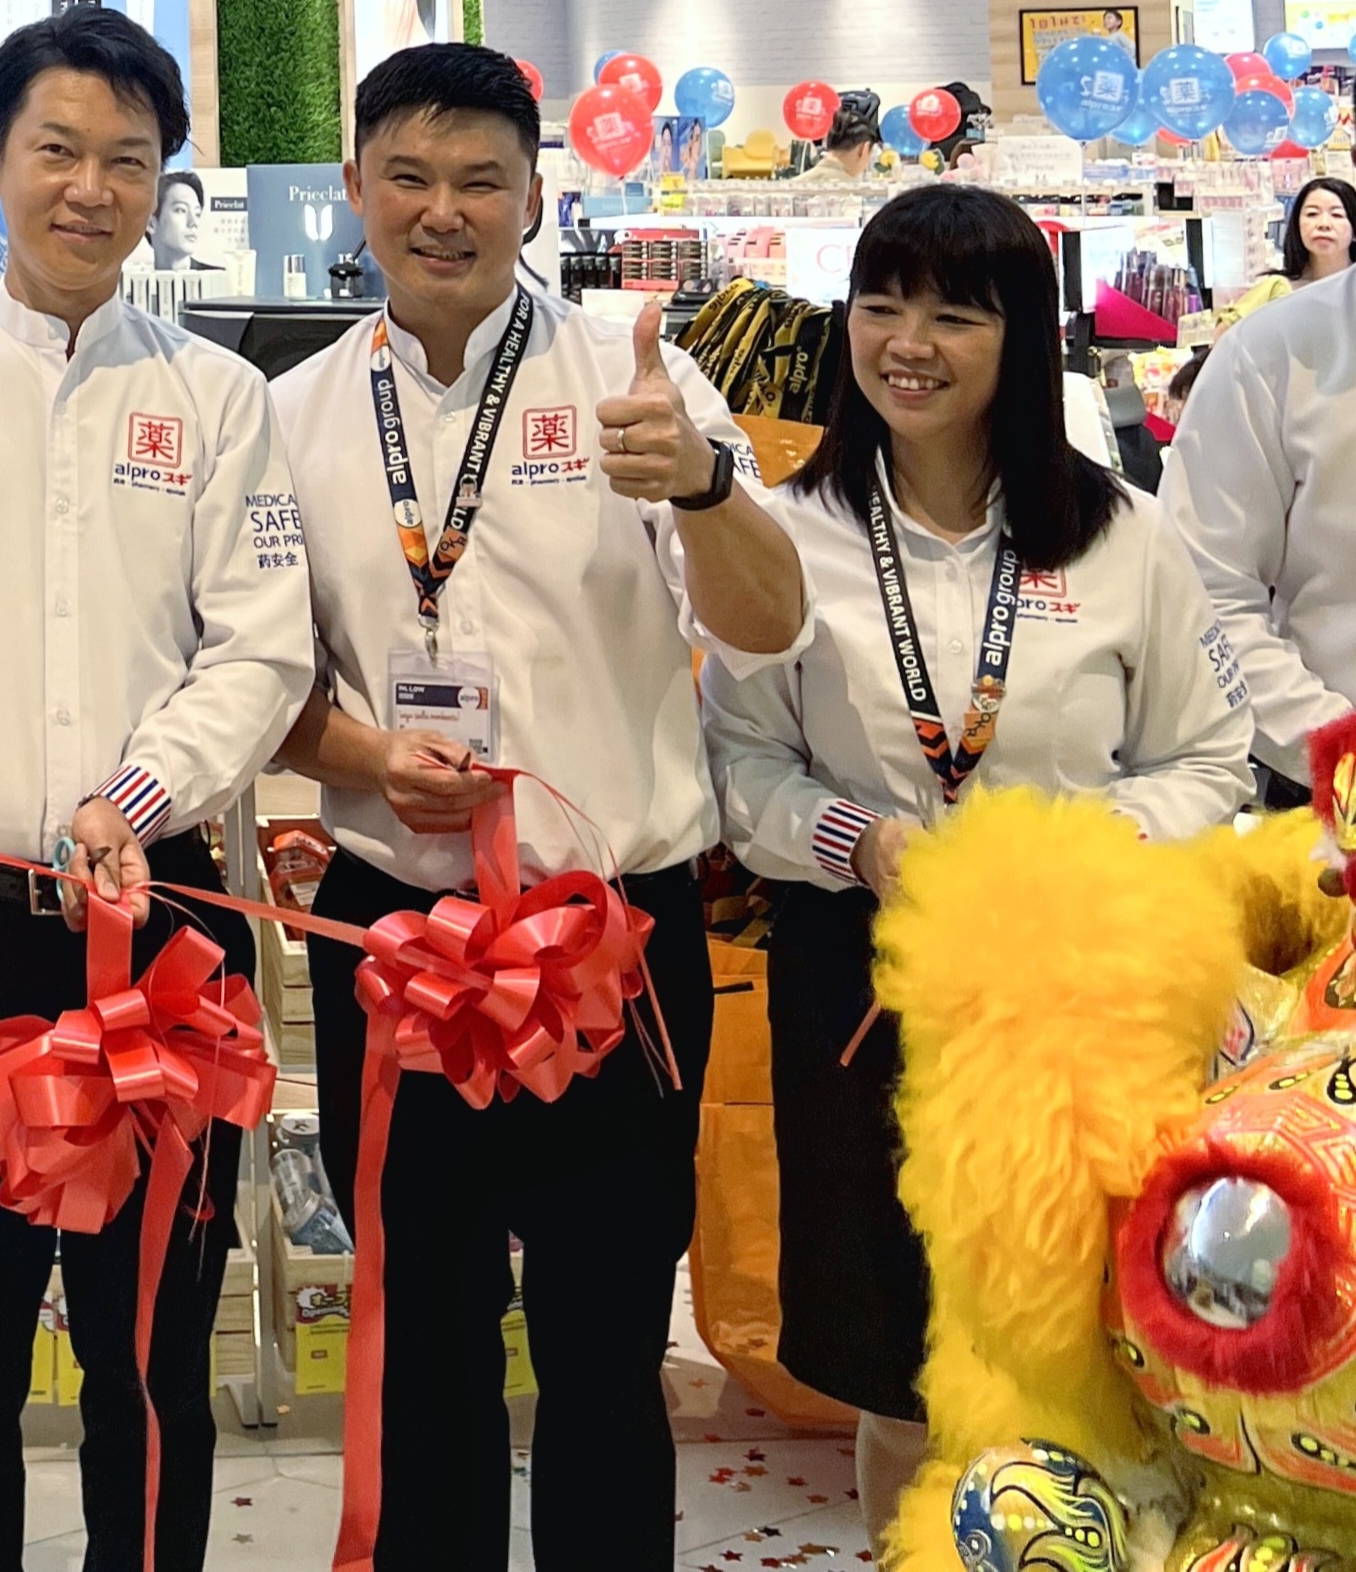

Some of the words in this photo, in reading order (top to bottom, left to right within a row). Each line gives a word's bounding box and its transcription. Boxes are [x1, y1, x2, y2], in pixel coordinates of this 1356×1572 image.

[289, 185, 346, 202] Prieclat
[519, 294, 530, 319] FOR
[516, 321, 524, 331] A
[493, 332, 520, 391] HEALTHY
[378, 379, 401, 429] group
[486, 393, 500, 404] &
[135, 421, 175, 460] 薬
[466, 407, 497, 478] VIBRANT
[531, 414, 569, 451] 薬
[114, 462, 161, 482] alpro
[162, 472, 193, 486] スギ
[385, 429, 408, 485] alpro
[512, 461, 559, 480] alpro
[561, 457, 590, 473] スギ
[254, 535, 281, 549] OUR
[879, 555, 893, 567] &
[994, 549, 1018, 606] group
[882, 568, 910, 642] VIBRANT
[982, 604, 1011, 666] alpro
[898, 638, 927, 702] WORLD
